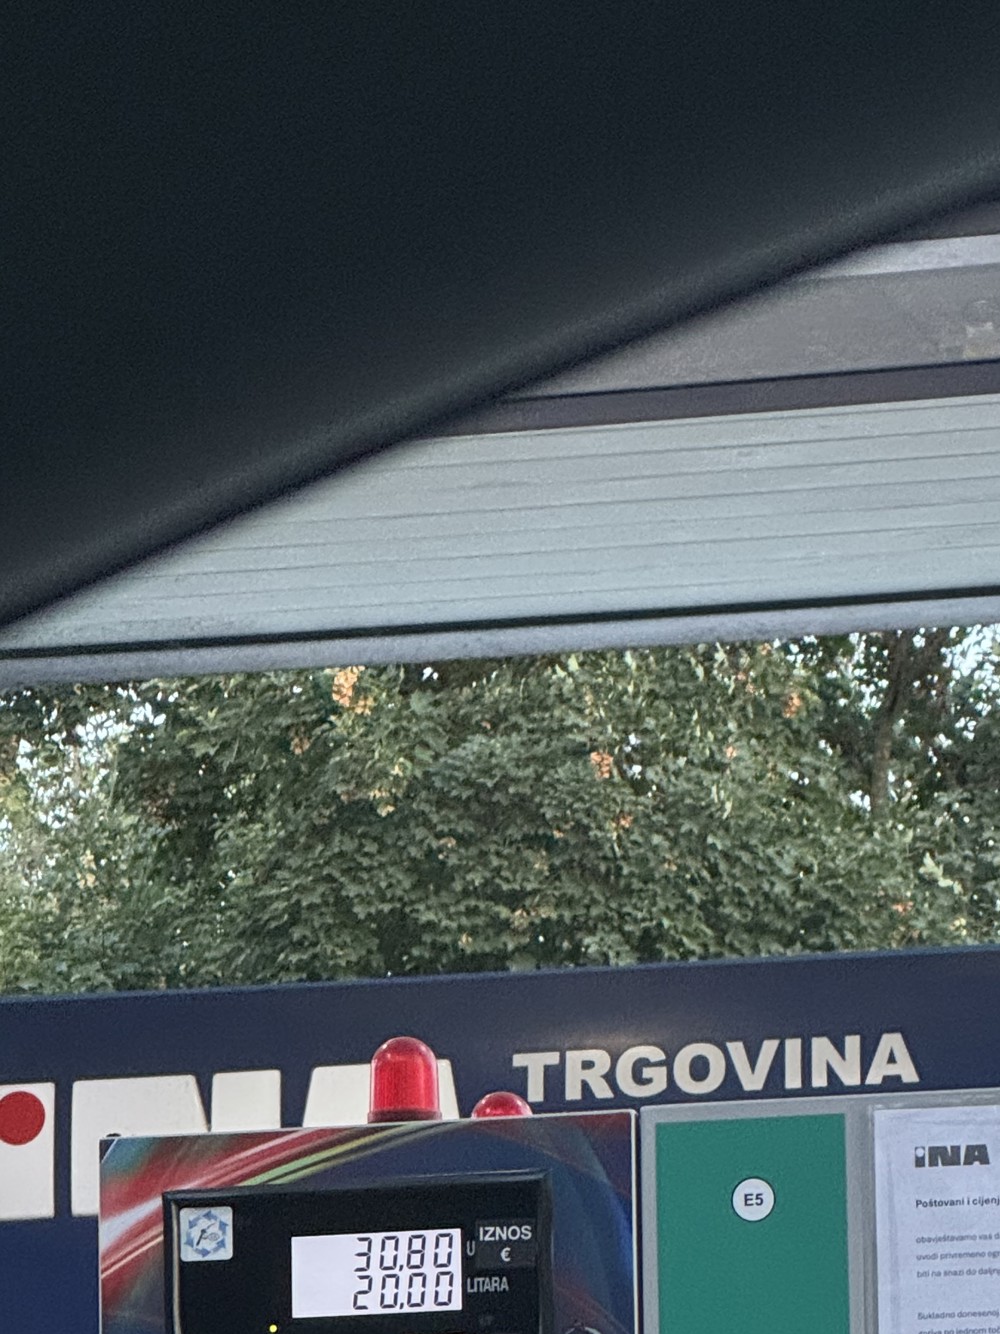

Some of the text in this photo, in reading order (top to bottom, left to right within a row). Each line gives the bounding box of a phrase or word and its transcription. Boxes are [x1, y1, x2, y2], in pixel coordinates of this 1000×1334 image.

[512, 1032, 920, 1102] TRGOVINA
[744, 1193, 764, 1207] E5
[479, 1225, 532, 1241] IZNOS
[353, 1232, 454, 1273] 30,80
[501, 1247, 511, 1262] €
[352, 1271, 455, 1310] 20,00
[466, 1276, 509, 1293] LITARA
